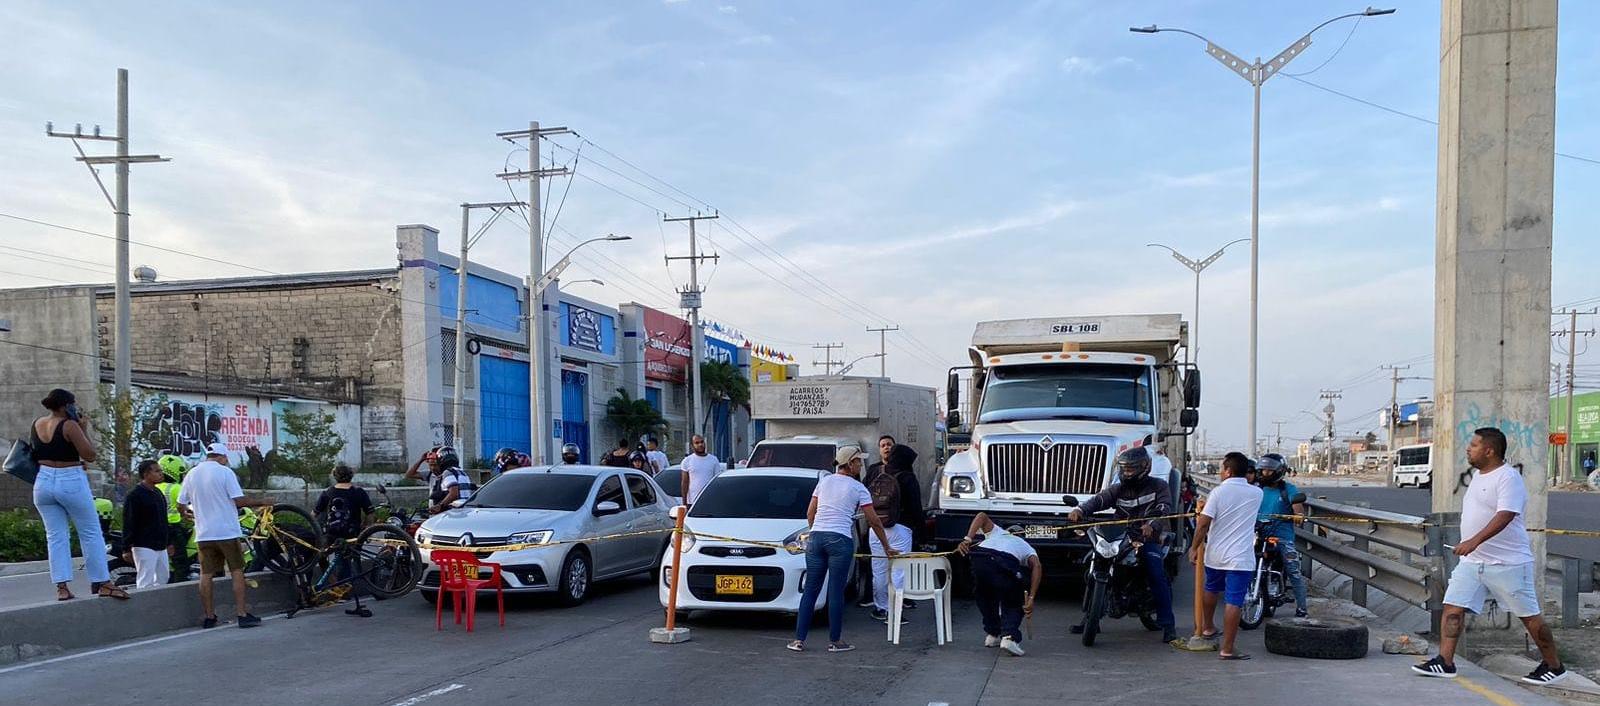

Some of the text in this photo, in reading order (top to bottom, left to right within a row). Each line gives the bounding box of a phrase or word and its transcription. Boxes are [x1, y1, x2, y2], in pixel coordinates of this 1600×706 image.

[1052, 324, 1098, 333] SBL 108
[235, 405, 248, 416] SE
[221, 417, 270, 436] RRIENDA
[227, 435, 256, 443] BODEGA
